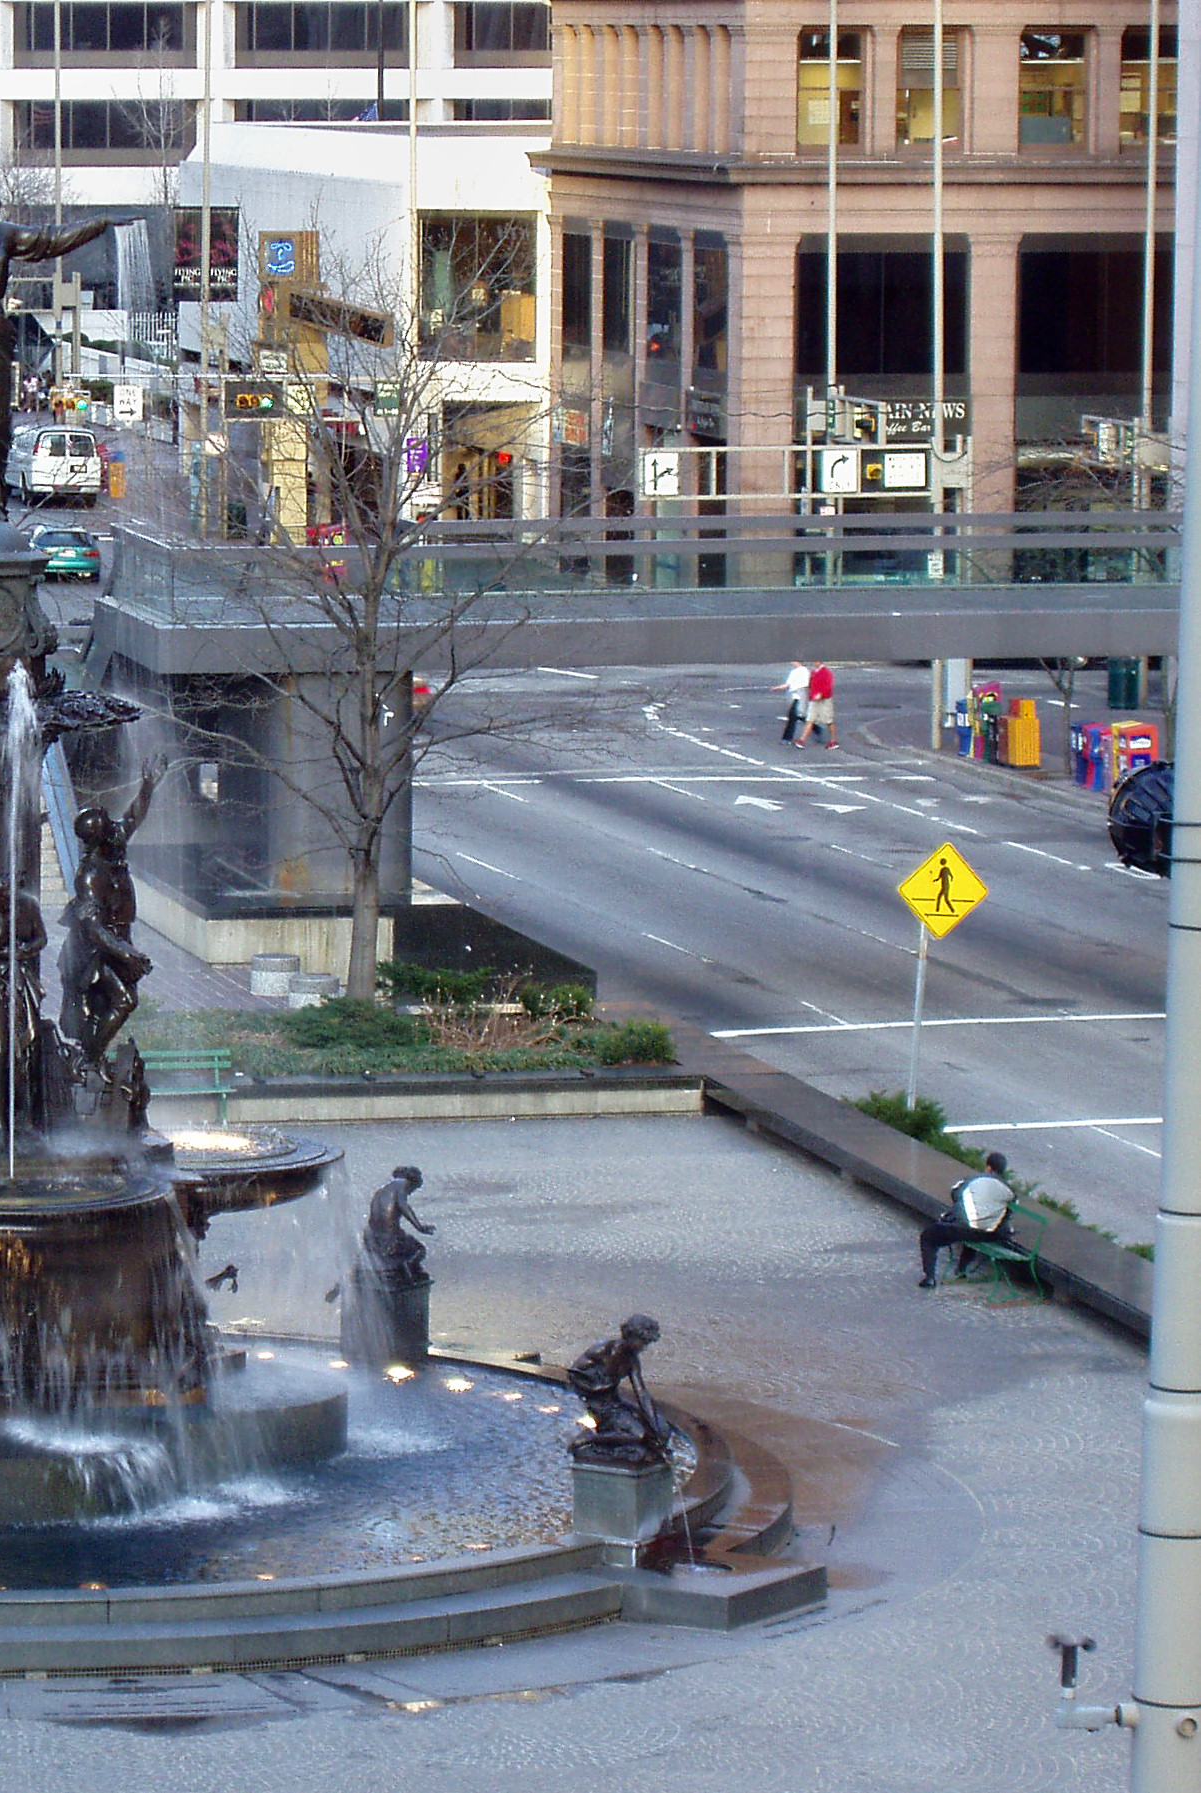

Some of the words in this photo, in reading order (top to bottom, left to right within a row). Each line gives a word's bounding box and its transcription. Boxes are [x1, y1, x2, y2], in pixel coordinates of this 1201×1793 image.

[119, 388, 136, 396] ONE
[886, 403, 912, 418] AIN
[919, 402, 965, 419] NWS
[911, 420, 932, 433] Bar
